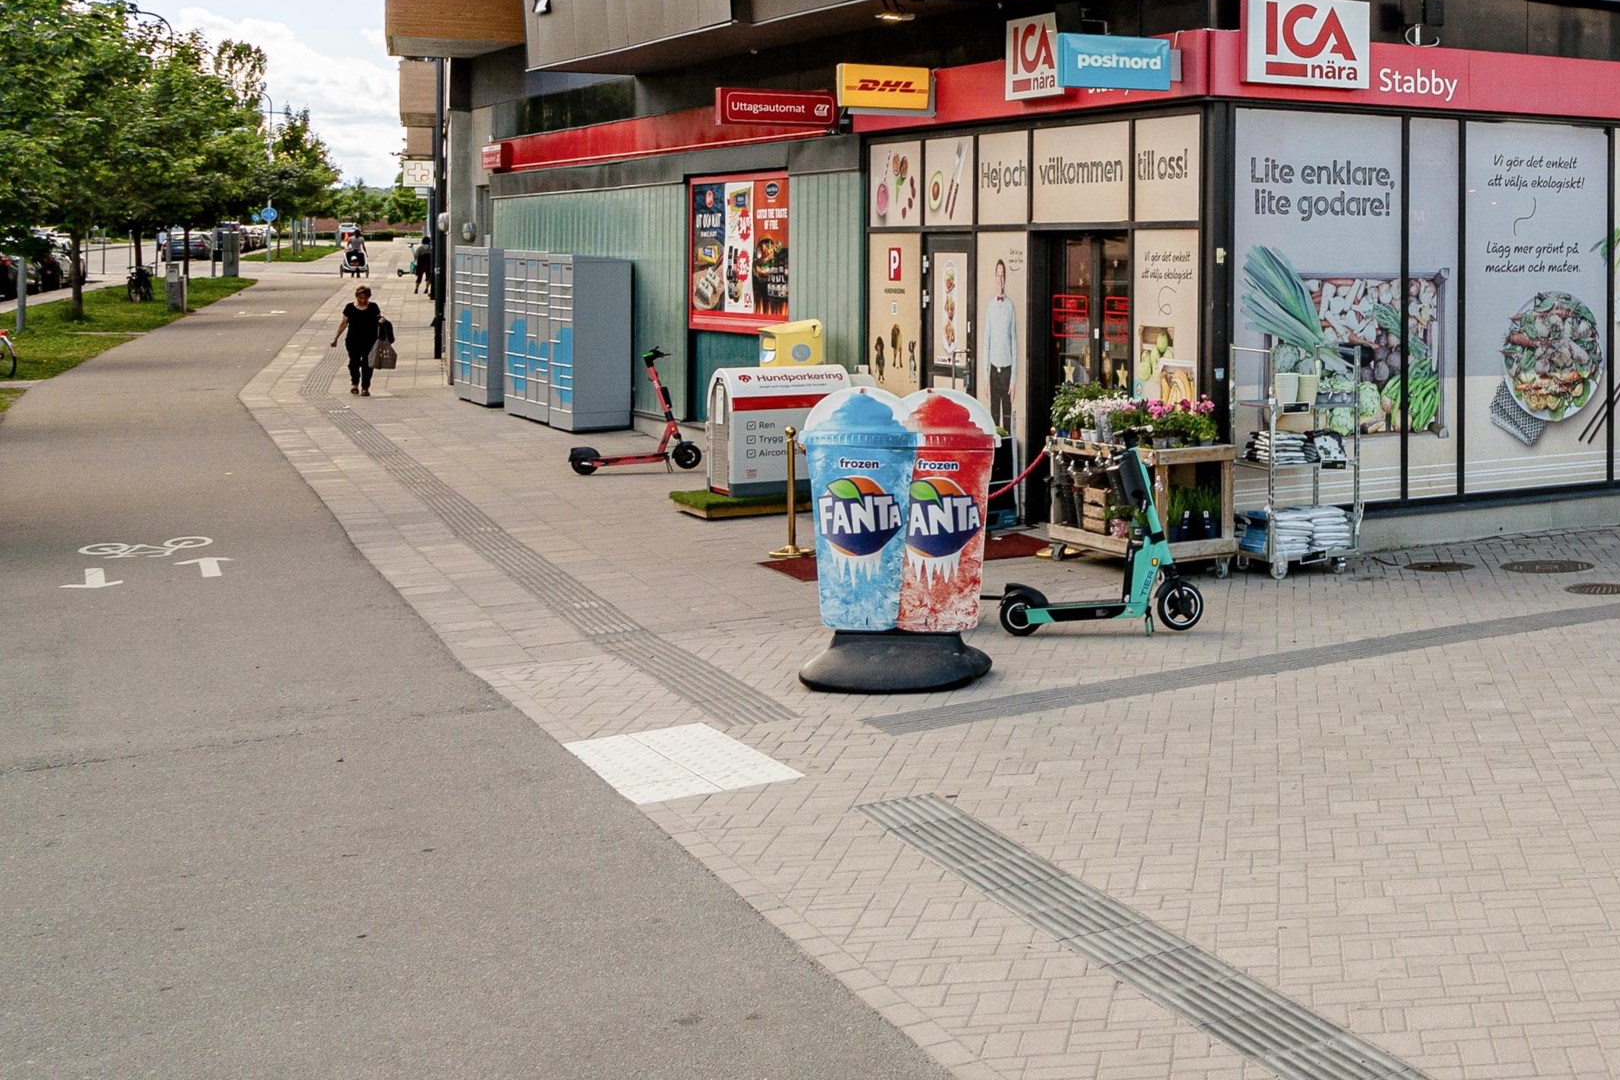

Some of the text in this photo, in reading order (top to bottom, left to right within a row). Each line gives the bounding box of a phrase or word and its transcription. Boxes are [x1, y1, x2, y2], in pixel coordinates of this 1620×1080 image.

[1266, 1, 1357, 61] ICA
[1013, 22, 1055, 75] ICA
[1077, 53, 1162, 70] postnord
[1311, 61, 1358, 81] nära
[858, 79, 916, 93] DHL
[1032, 72, 1055, 91] nära
[1379, 68, 1458, 102] Stabby
[731, 101, 806, 114] Uttagsautomat
[981, 148, 1189, 194] Hej och välkommen till oss!
[1493, 154, 1578, 172] Vi gör det enkelt
[1250, 156, 1396, 190] Lite enklare,
[1487, 173, 1586, 194] att välja ekologiskt!
[1254, 189, 1391, 222] lite godare!
[1144, 250, 1191, 266] Vi gör det enkelt
[1486, 241, 1580, 259] Lägg mer grönt på
[890, 250, 899, 279] P
[1485, 259, 1581, 273] mackan och maten.
[1150, 268, 1163, 282] välja
[757, 372, 843, 386] Hundparkering
[758, 421, 775, 429] Ren
[758, 435, 784, 444] Trygg
[839, 458, 879, 469] frozen
[917, 460, 959, 470] frozen
[818, 495, 902, 535] FANTA
[908, 496, 981, 536] ANTA
[1140, 569, 1155, 597] TIER
